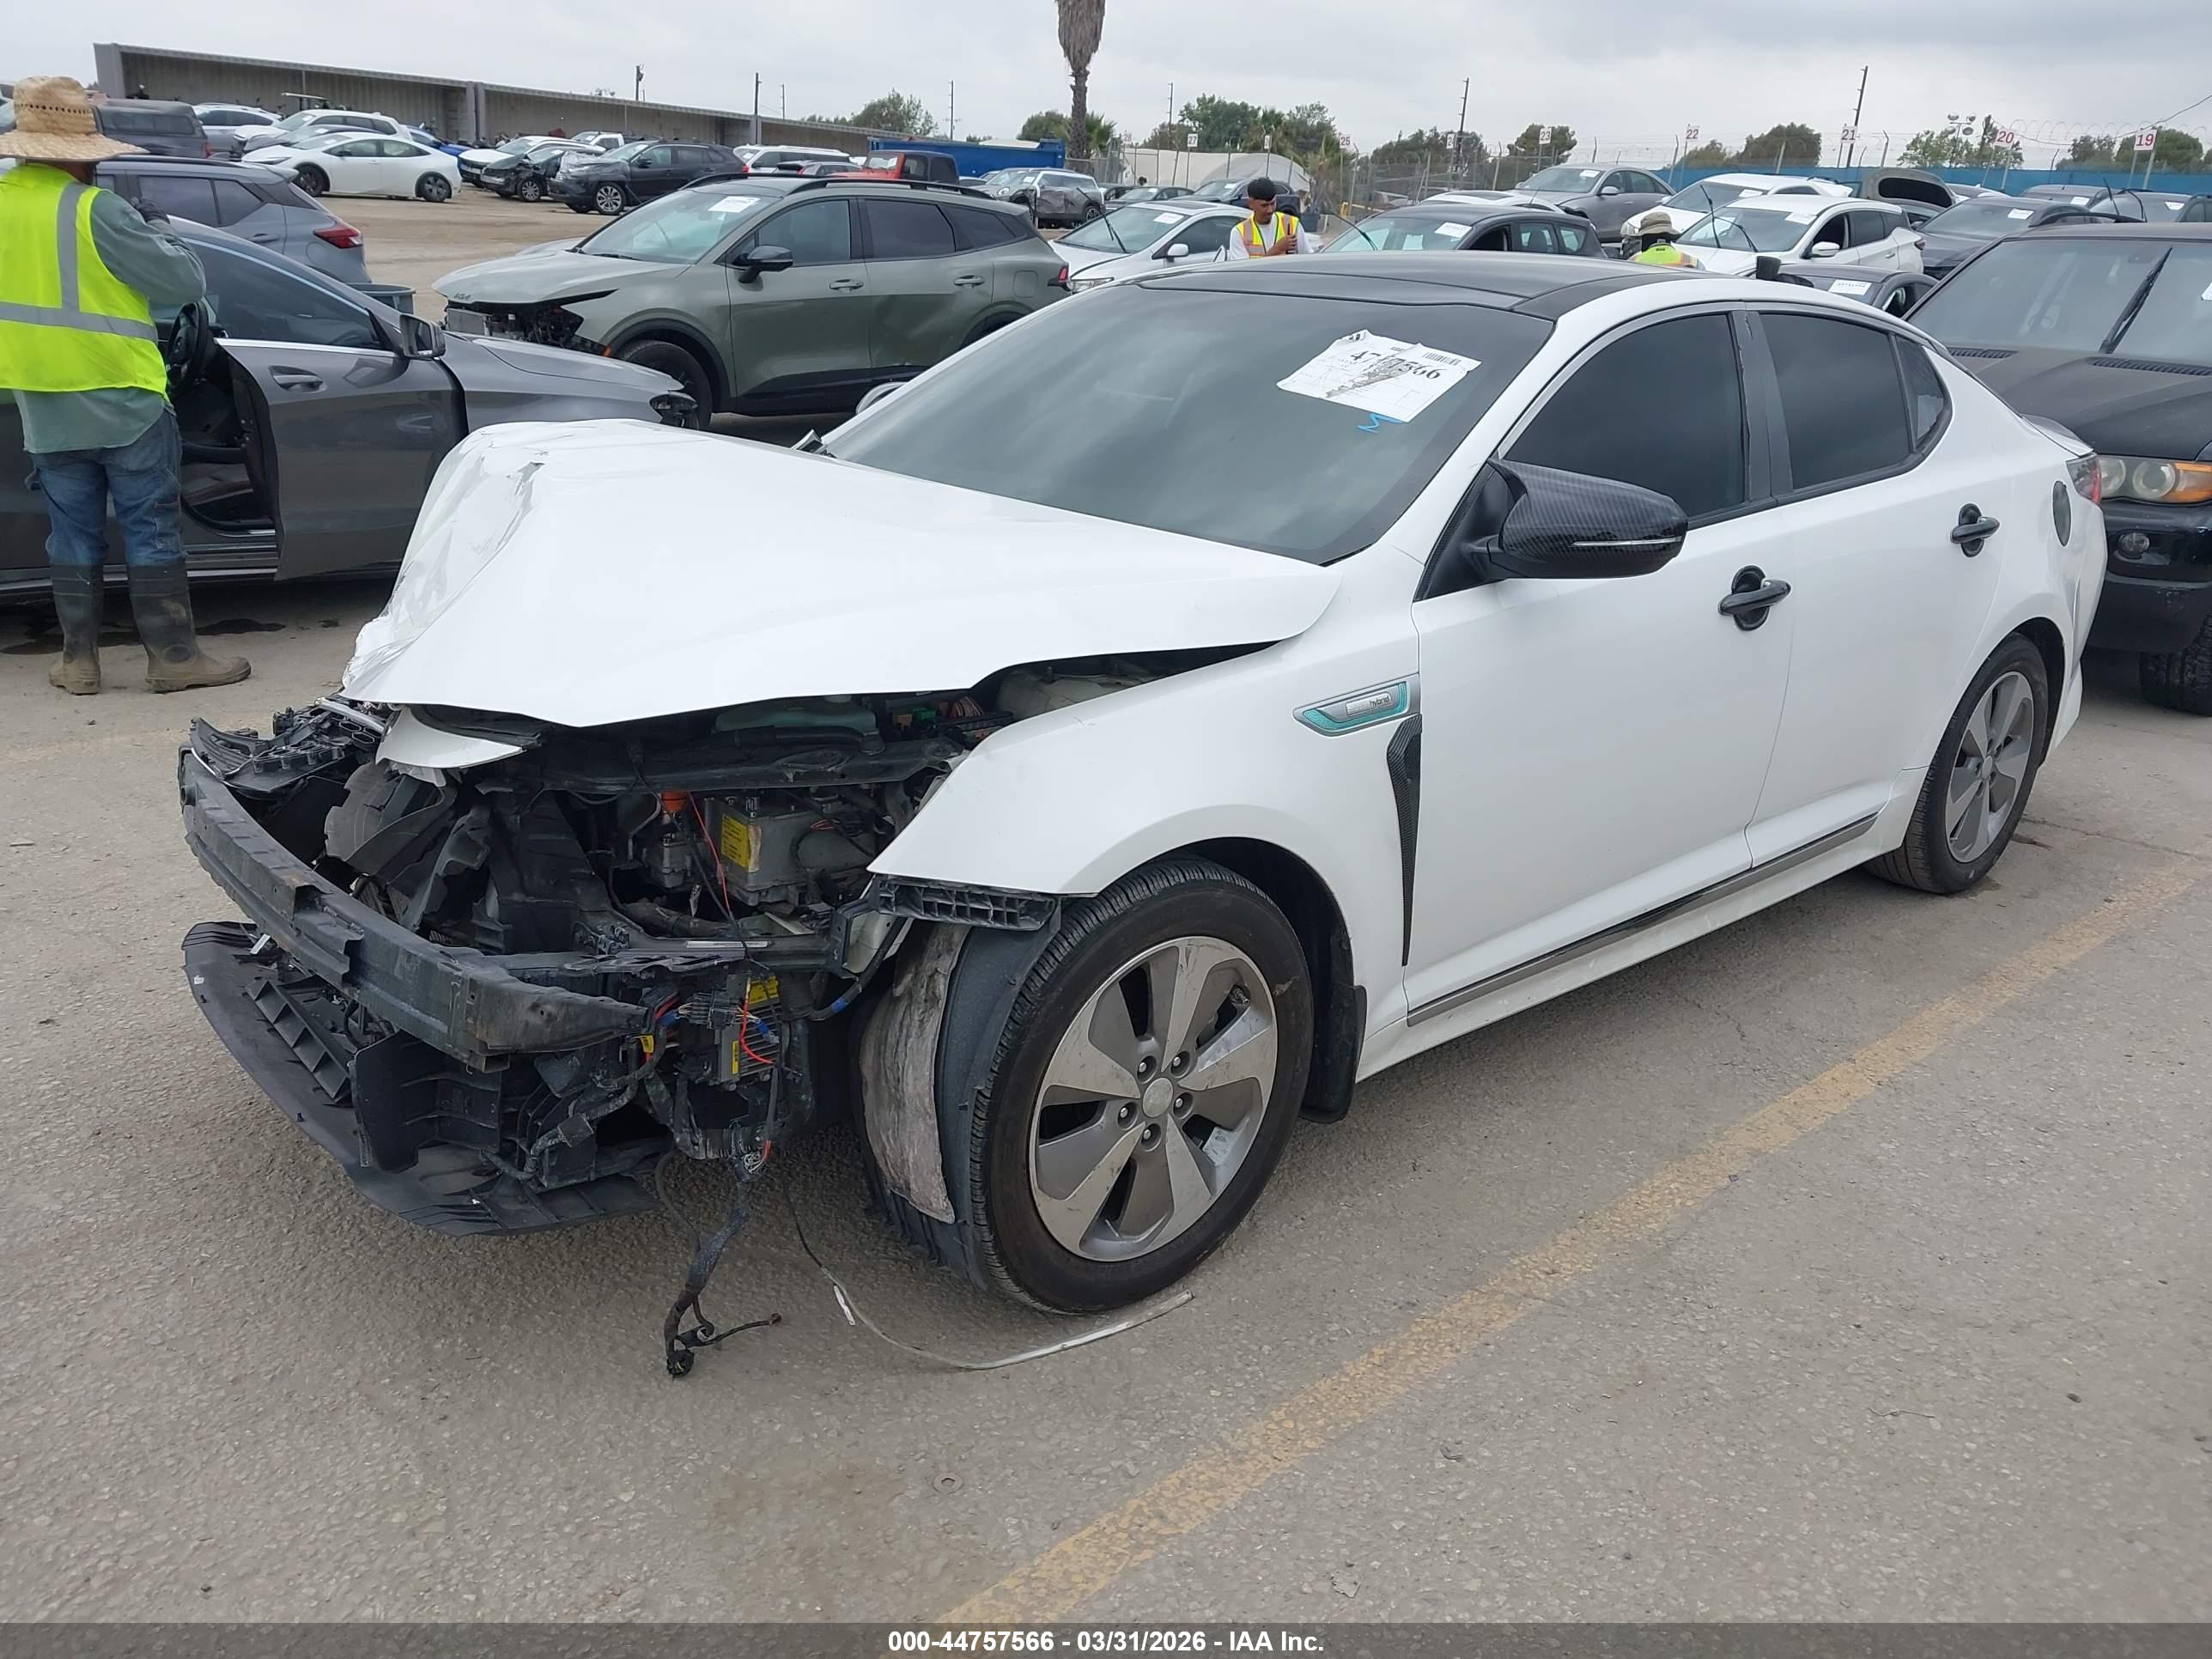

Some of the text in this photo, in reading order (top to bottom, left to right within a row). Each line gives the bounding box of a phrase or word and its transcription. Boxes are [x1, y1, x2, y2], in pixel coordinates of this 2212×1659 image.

[1188, 136, 1197, 144] 27
[1540, 131, 1551, 141] 23
[1686, 129, 1699, 140] 22
[1841, 129, 1856, 141] 21
[1996, 130, 2014, 144] 20
[2136, 132, 2154, 147] 19
[1340, 137, 1351, 146] 25
[1369, 696, 1389, 708] hybrid
